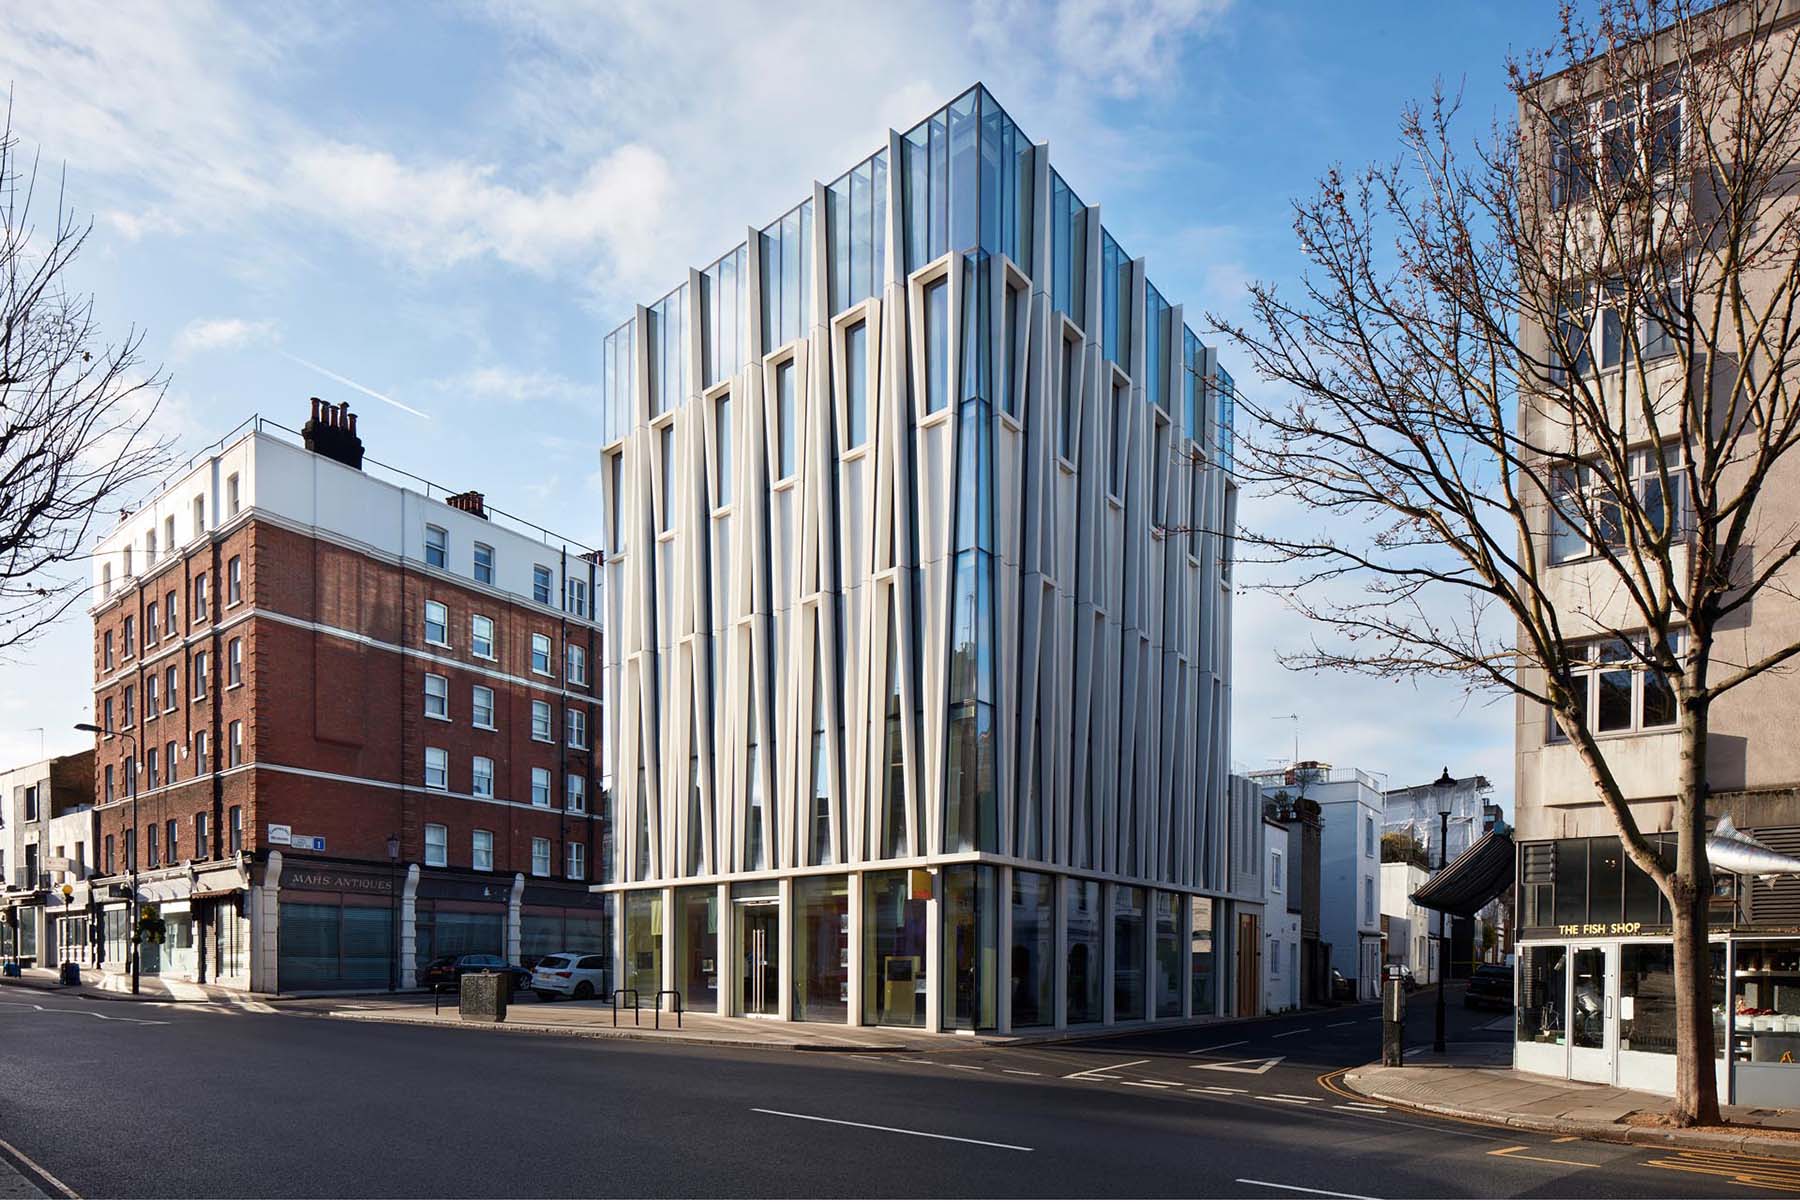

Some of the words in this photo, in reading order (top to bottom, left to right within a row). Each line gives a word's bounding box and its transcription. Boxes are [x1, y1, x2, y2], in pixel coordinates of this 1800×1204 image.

[334, 878, 392, 889] ANTIQUES
[1559, 925, 1579, 934] THE
[1583, 924, 1606, 934] FISH
[1611, 922, 1640, 933] SHOP
